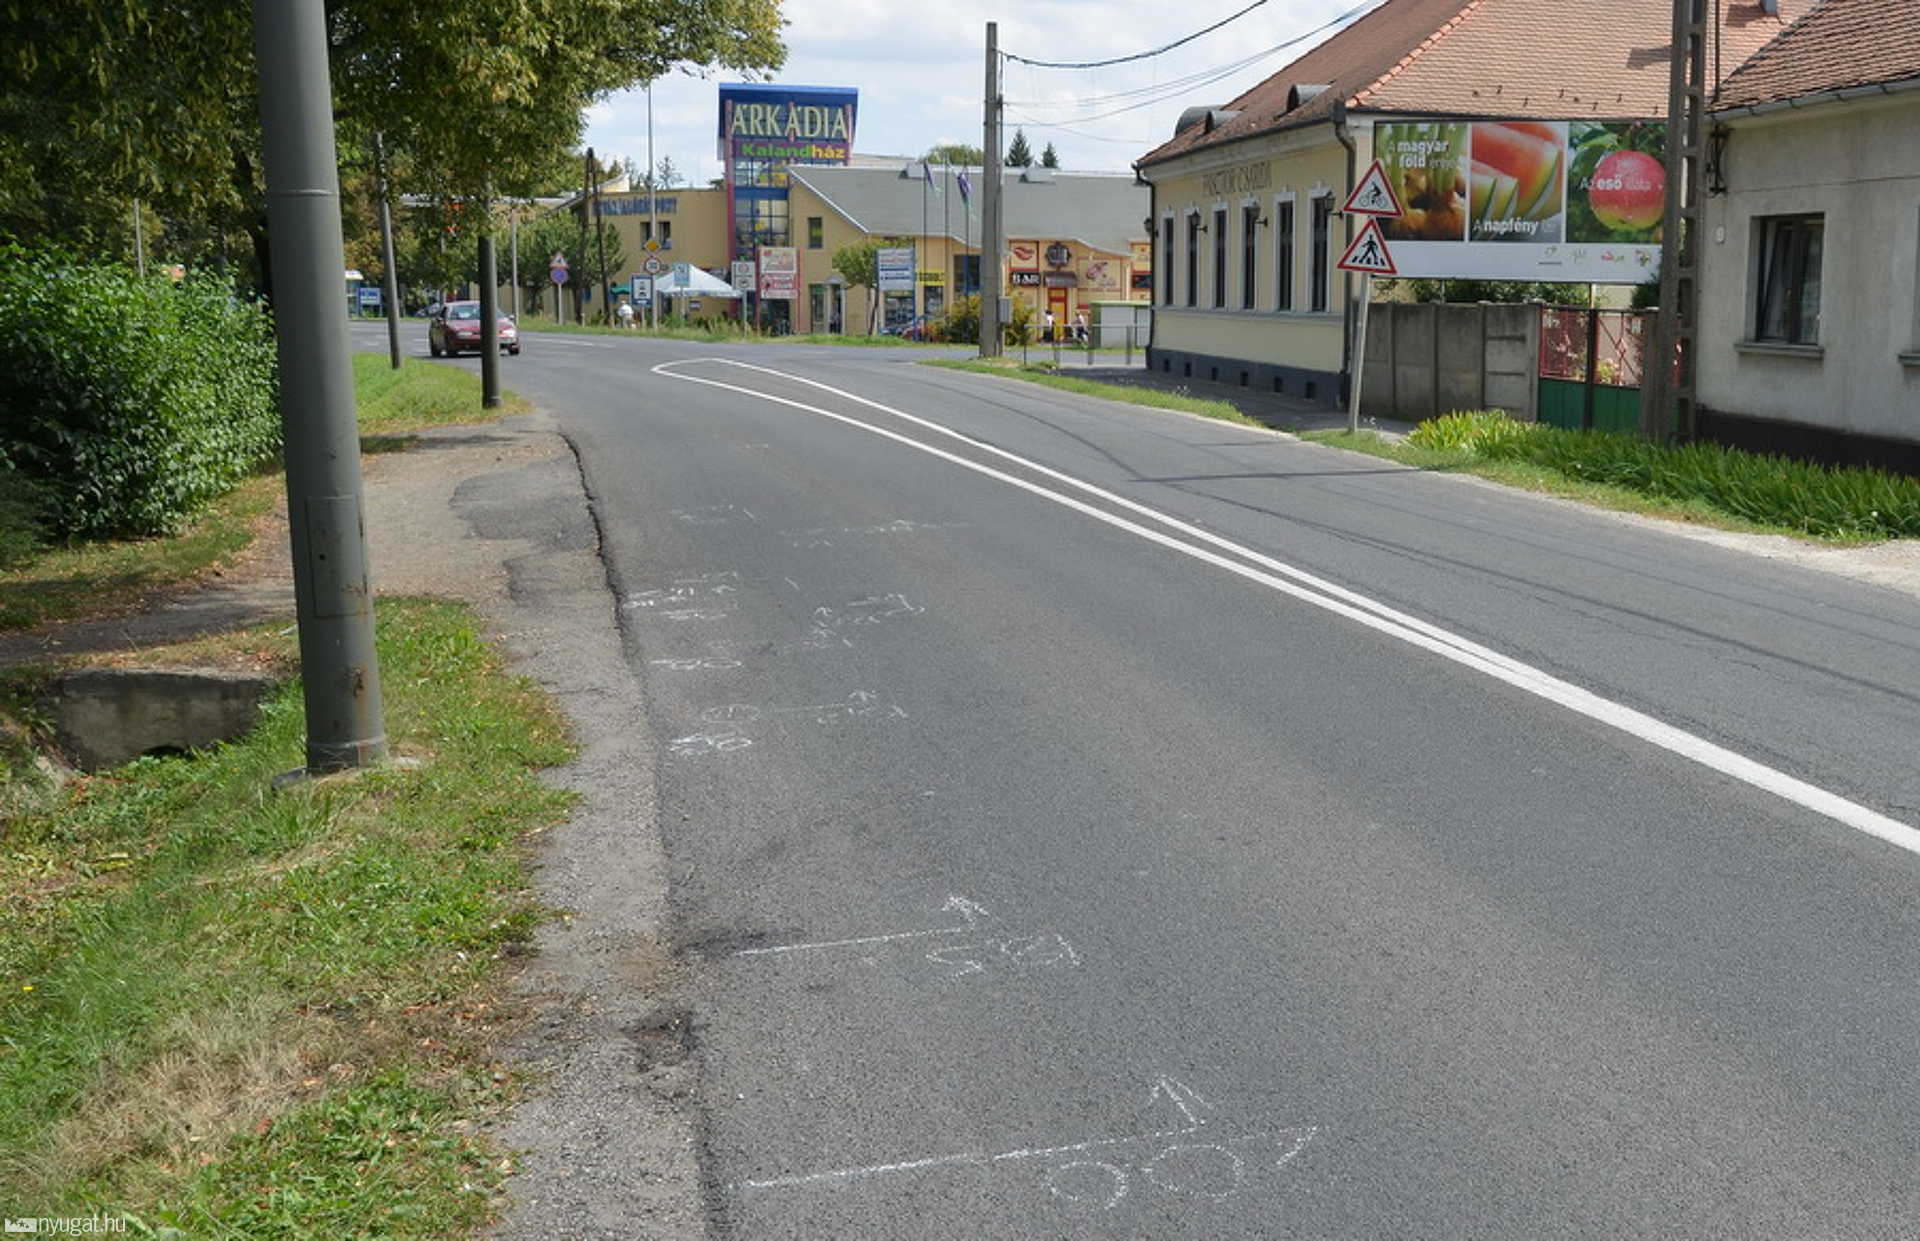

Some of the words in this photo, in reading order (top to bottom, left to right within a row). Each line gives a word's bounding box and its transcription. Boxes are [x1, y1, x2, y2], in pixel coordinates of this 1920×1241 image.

[1397, 140, 1449, 154] magyar
[1400, 153, 1426, 168] föld
[1597, 175, 1622, 191] eső
[1484, 217, 1539, 235] napfény
